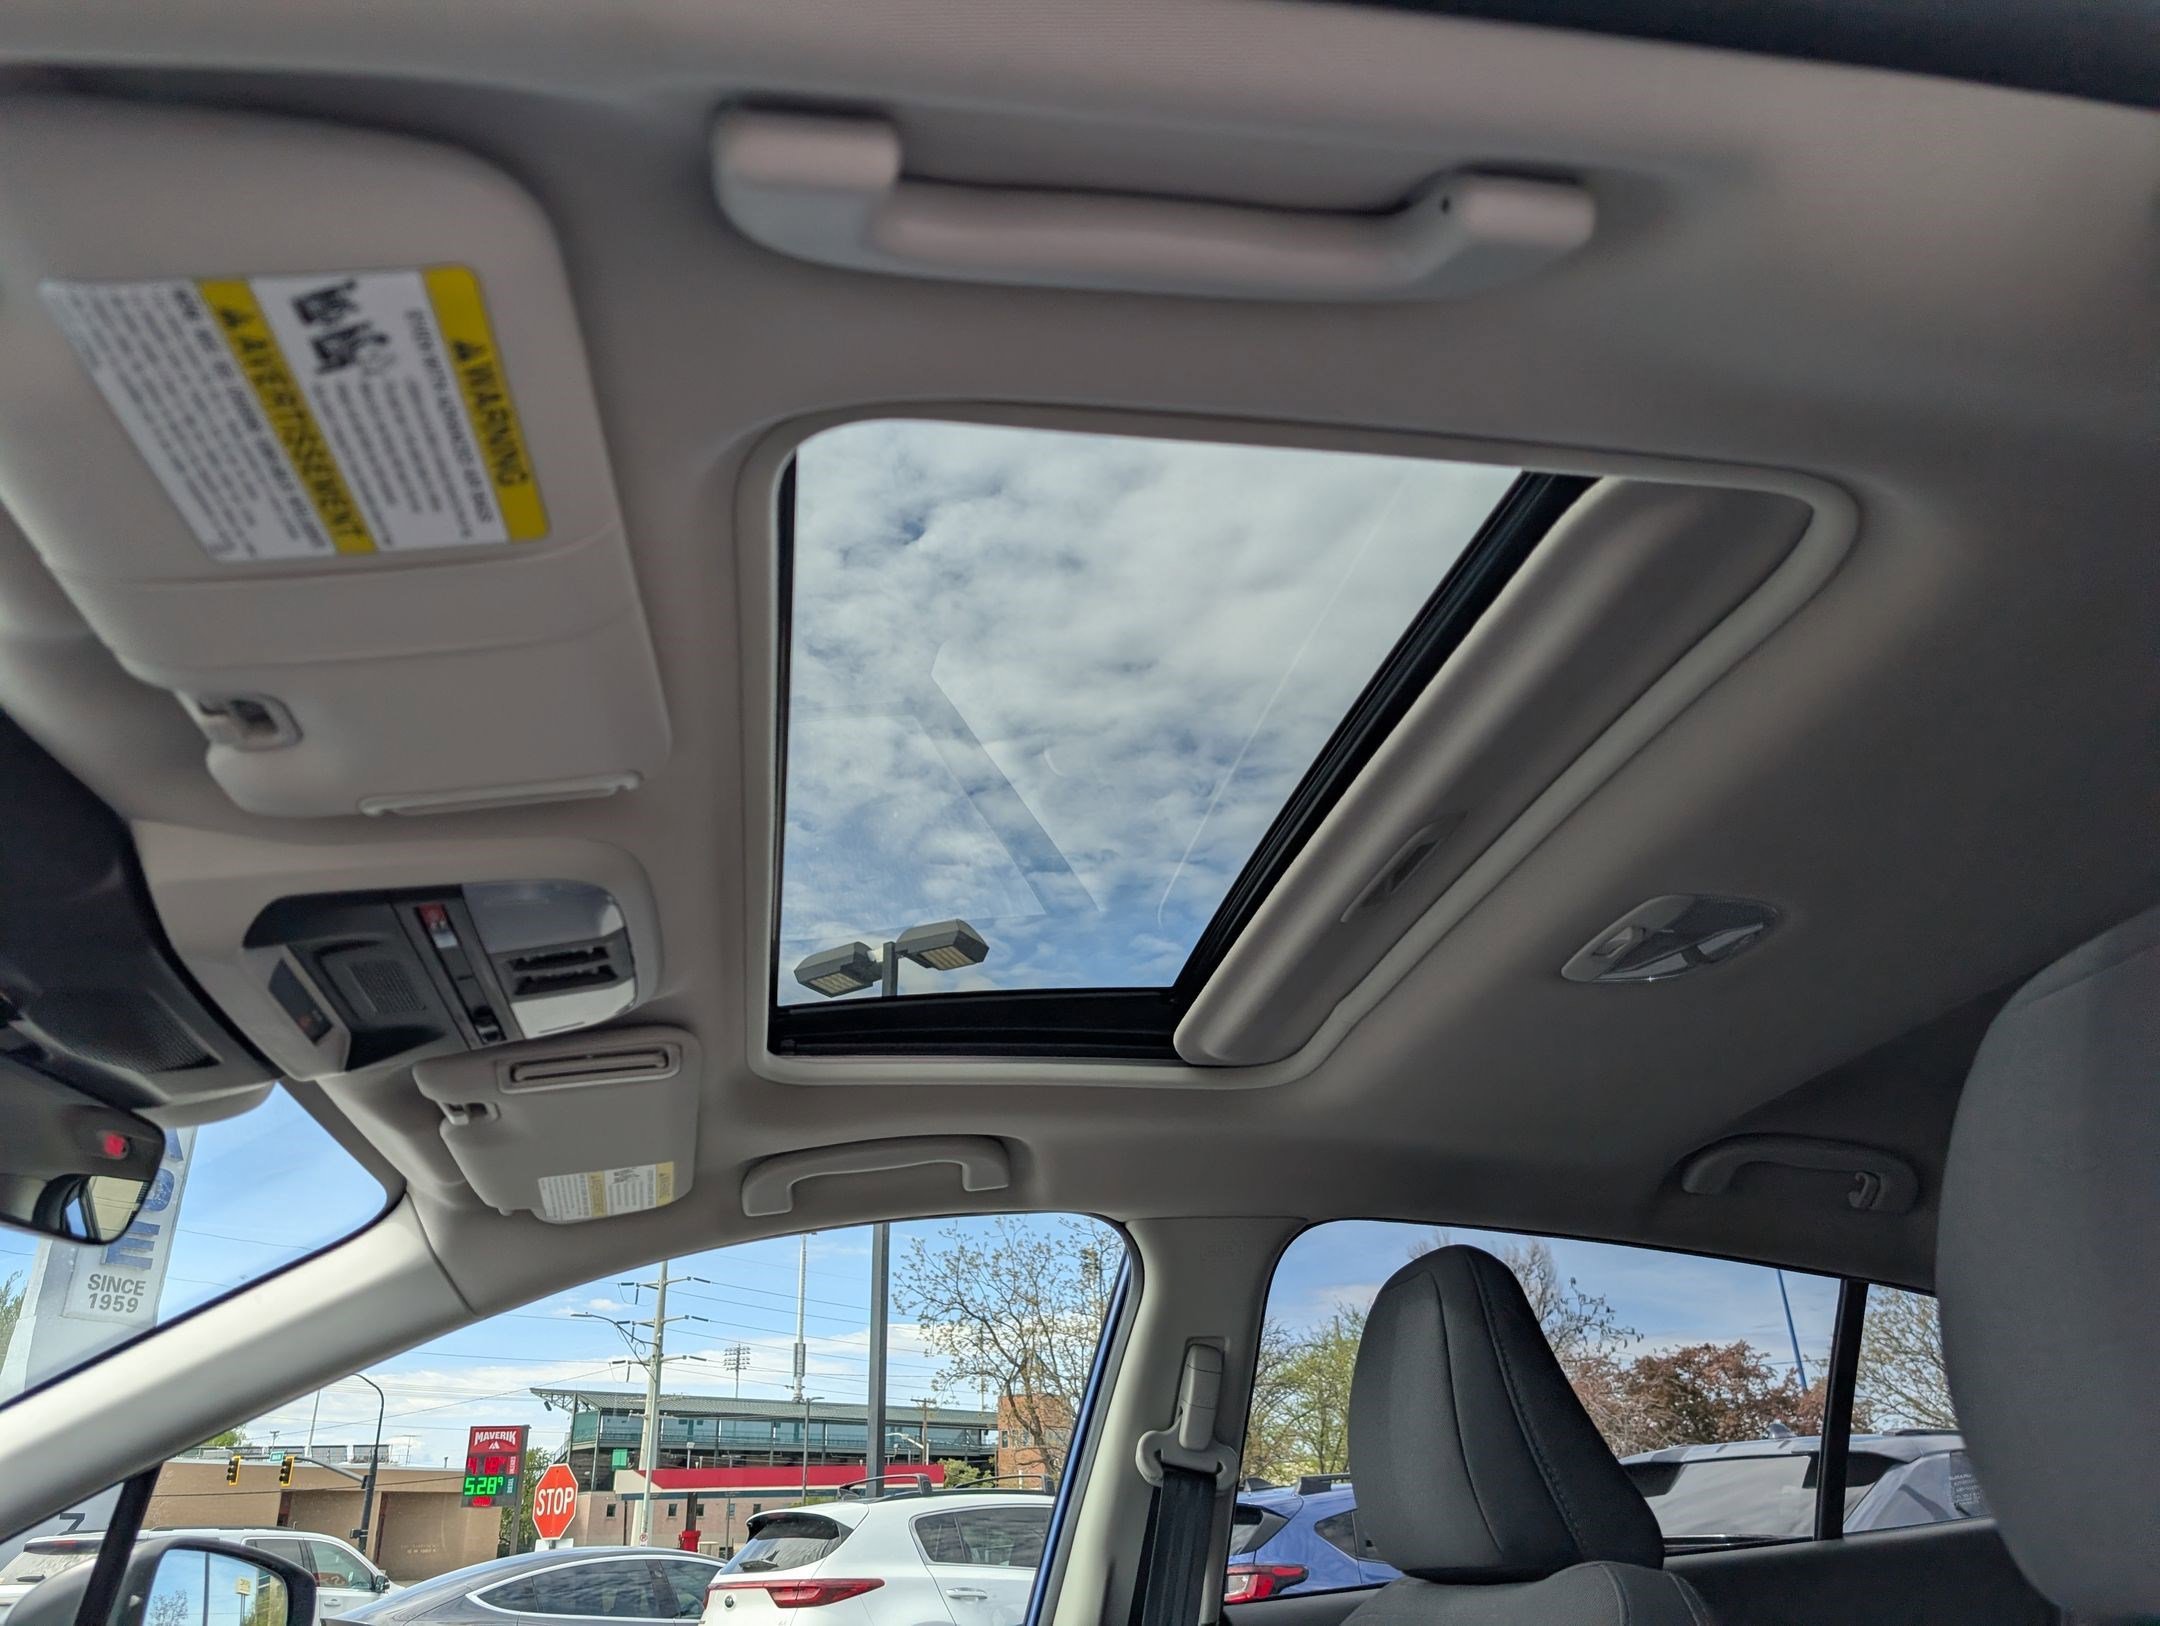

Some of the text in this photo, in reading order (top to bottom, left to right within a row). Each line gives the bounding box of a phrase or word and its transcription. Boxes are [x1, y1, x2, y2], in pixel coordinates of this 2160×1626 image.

[463, 364, 529, 487] WARNING
[88, 1273, 146, 1296] SINCE
[89, 1293, 139, 1313] 1959
[474, 1431, 516, 1447] MAVERIK
[536, 1487, 575, 1516] STOP
